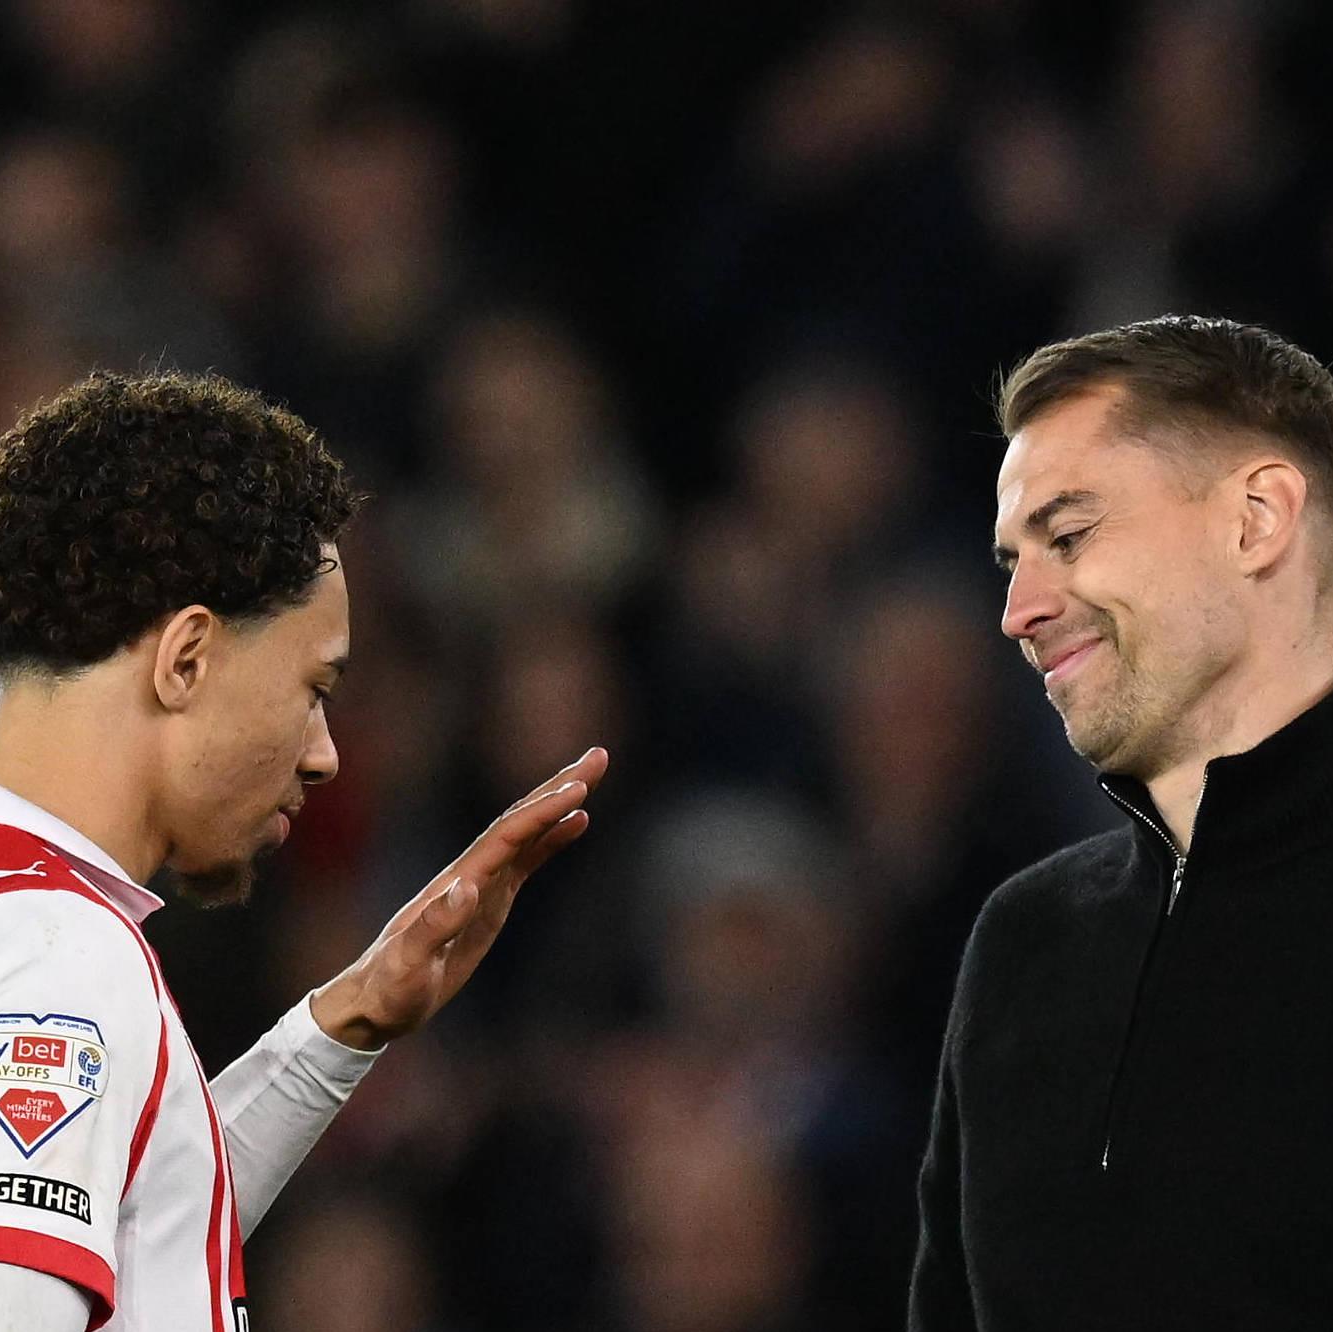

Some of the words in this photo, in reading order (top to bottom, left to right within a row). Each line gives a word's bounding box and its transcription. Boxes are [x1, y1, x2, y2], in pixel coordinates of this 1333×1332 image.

[18, 1039, 61, 1061] bet
[78, 1074, 98, 1092] EFL
[12, 1111, 52, 1122] MATTERS
